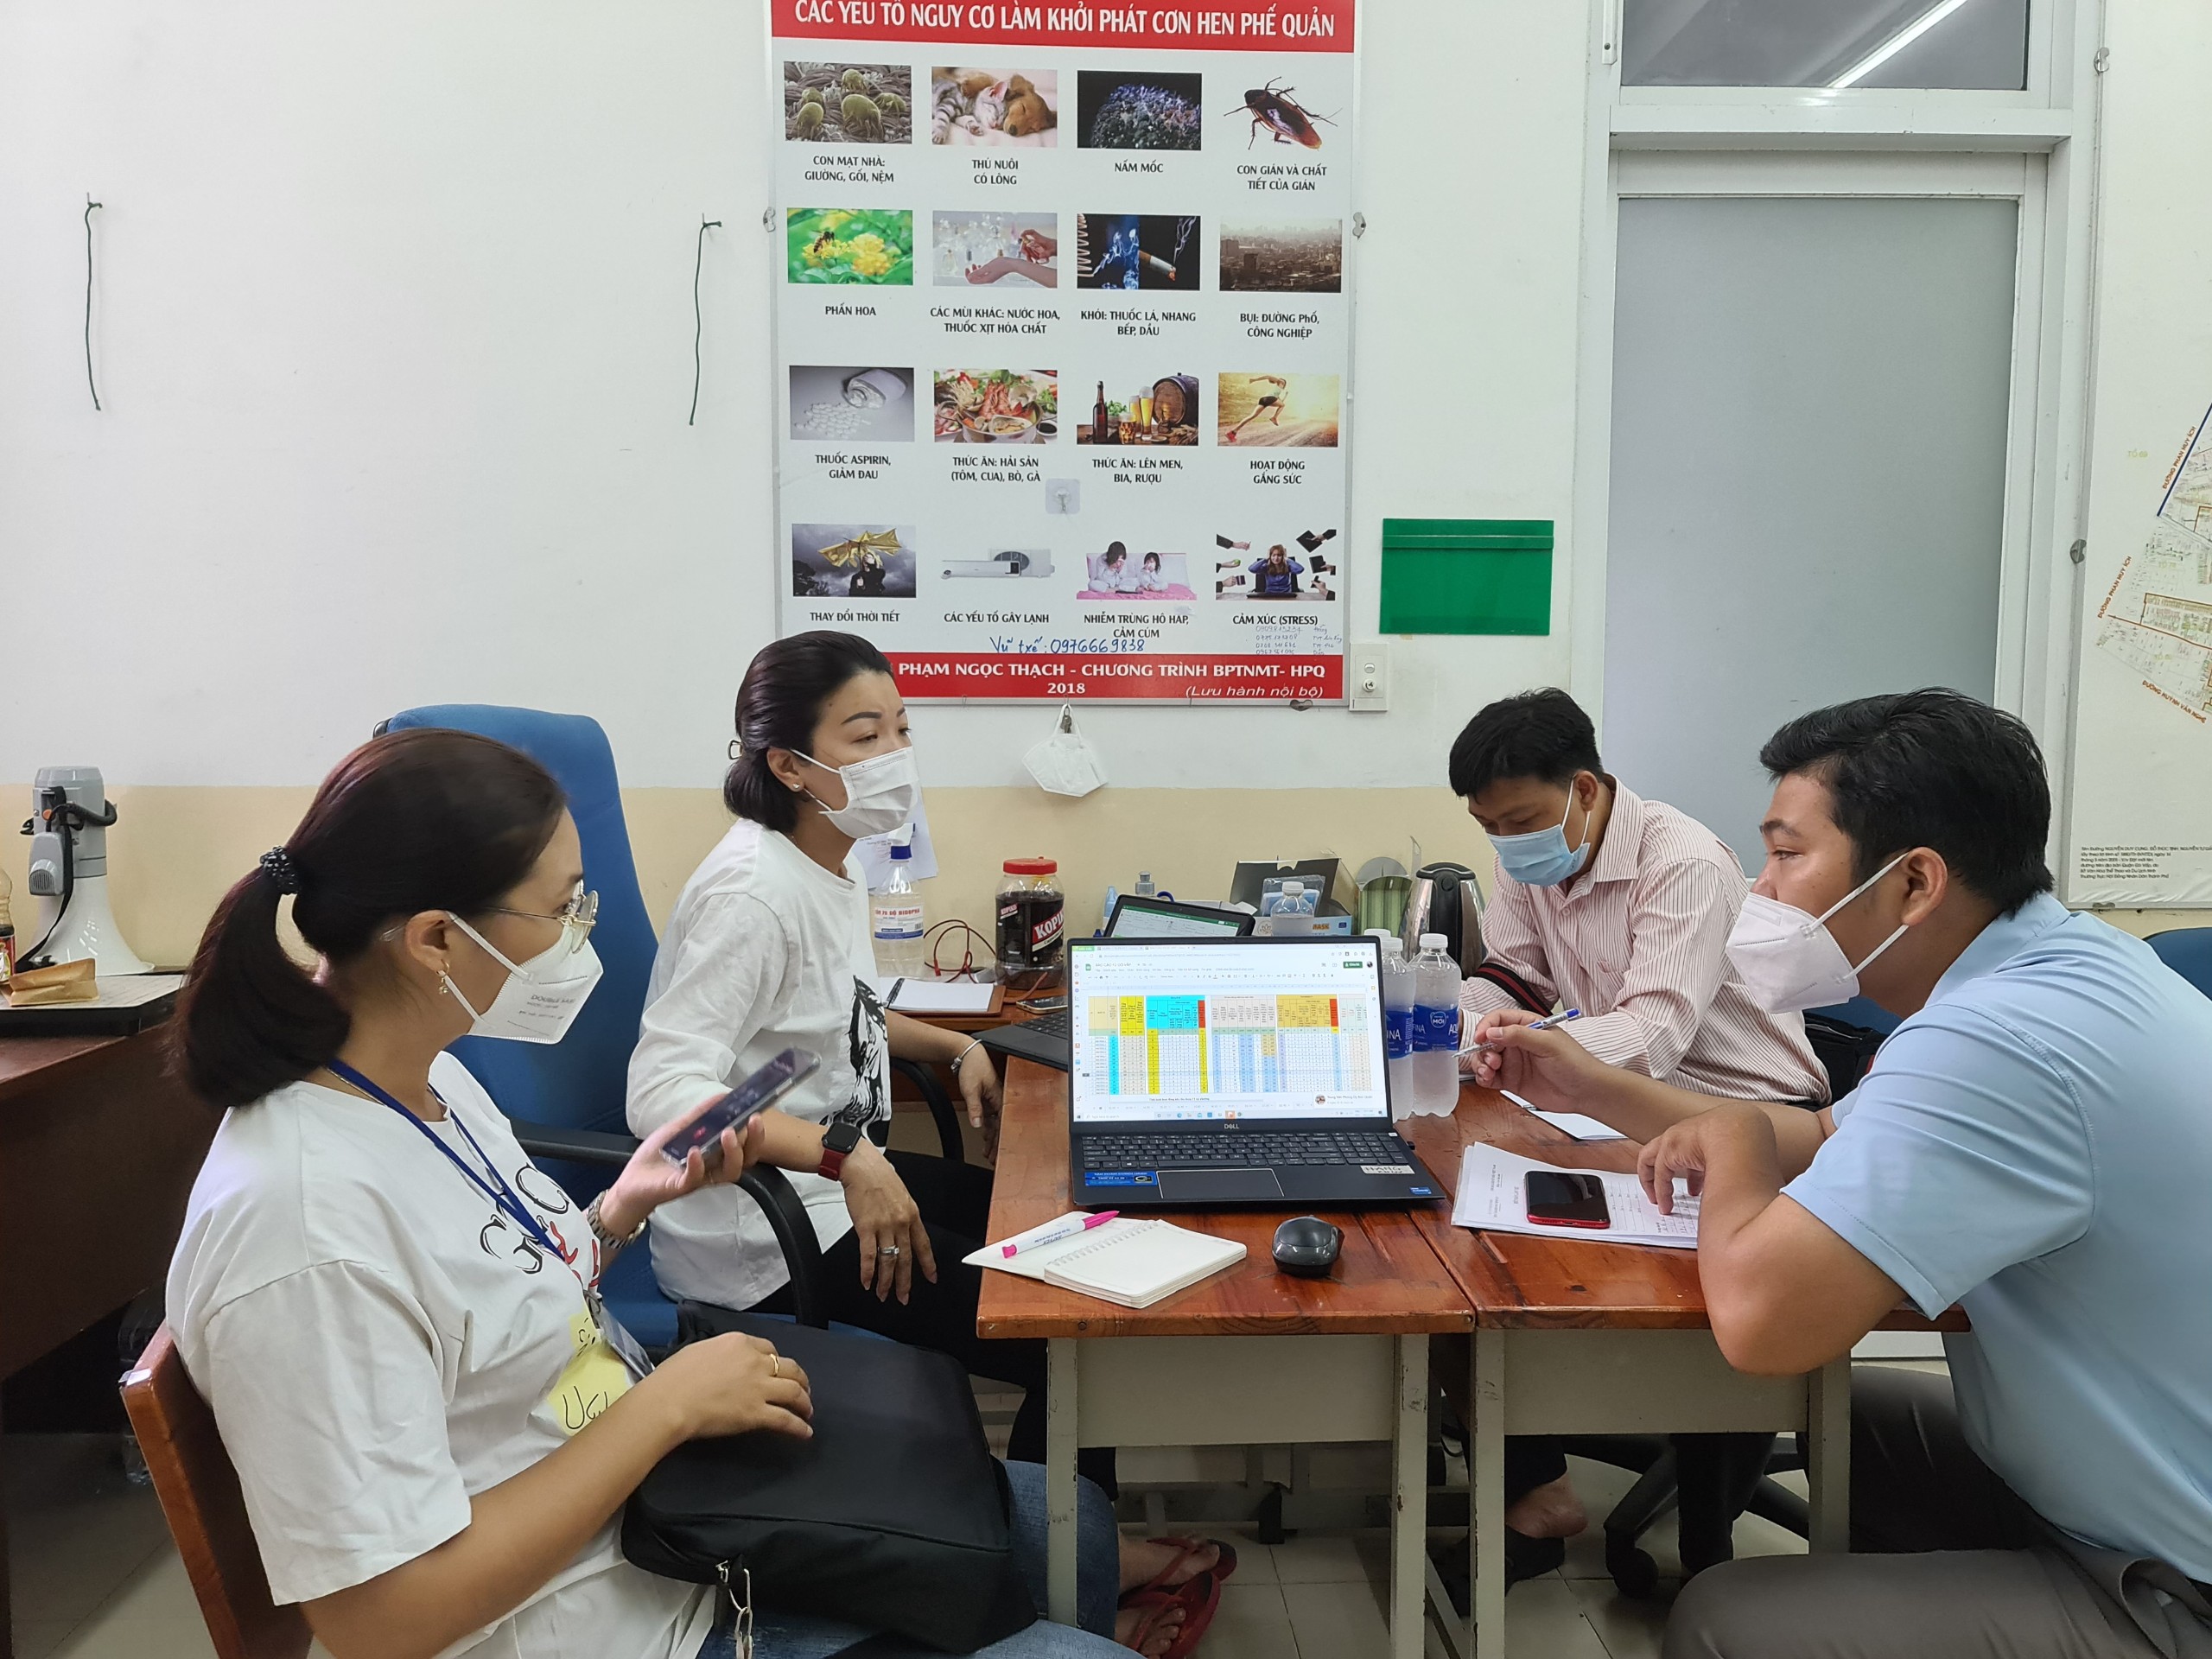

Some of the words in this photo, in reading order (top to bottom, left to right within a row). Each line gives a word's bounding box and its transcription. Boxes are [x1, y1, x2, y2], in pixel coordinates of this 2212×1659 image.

[910, 3, 964, 29] NGUY
[968, 3, 996, 29] CƠ
[1000, 1, 1041, 31] LÀM
[1046, 1, 1093, 32] KHỞI
[1098, 3, 1148, 34] PHÁT
[1152, 9, 1192, 35] CƠN
[1197, 11, 1235, 36] HEN
[1240, 3, 1277, 36] PHẾ
[1281, 5, 1335, 39] QUẢN
[812, 156, 835, 166] CON
[836, 156, 859, 168] MẠT
[861, 155, 886, 167] NHÀ:
[971, 157, 992, 169] THÚ
[994, 157, 1019, 170] NUÔI
[1114, 158, 1138, 173] NẤM
[1140, 159, 1164, 173] MỐC
[1236, 164, 1257, 175] CON
[1260, 163, 1284, 175] GIÁN
[1286, 163, 1300, 175] VÀ
[1301, 162, 1328, 176] CHẤT
[871, 169, 894, 185] NỆM
[973, 172, 988, 185] CÓ
[990, 172, 1017, 185] LÔNG
[1247, 176, 1268, 190] TIẾT
[1268, 177, 1289, 191] CỦA
[1291, 178, 1316, 191] GIÁN
[824, 302, 853, 315] PHẤN
[855, 306, 877, 316] HOA
[930, 305, 950, 318] CÁC
[952, 306, 972, 321] MÙI
[975, 306, 1005, 319] KHÁC:
[1007, 307, 1035, 319] NƯỚC
[1080, 308, 1108, 321] KHÓI:
[1109, 307, 1142, 321] THUỐC
[1161, 312, 1197, 321] NHANG
[1240, 313, 1259, 325] BỤI:
[1262, 311, 1296, 323] ĐƯỜNG
[944, 319, 977, 333] THUỐC
[979, 323, 995, 335] XỊT
[997, 321, 1019, 334] HÓA
[1020, 321, 1047, 334] CHẤT
[1139, 322, 1160, 336] DẦU
[1247, 325, 1274, 338] CÔNG
[1276, 326, 1313, 340] NGHIỆP
[815, 451, 849, 465] THUỐC
[2173, 450, 2184, 467] PHAN
[2181, 437, 2190, 450] HUY
[952, 454, 978, 467] THỨC
[980, 455, 997, 467] ĂN:
[1000, 454, 1017, 467] HẢI
[1019, 454, 1039, 467] SẢN
[1091, 456, 1117, 468] THỨC
[1119, 457, 1136, 468] ĂN:
[1139, 456, 1157, 469] LÊN
[1249, 460, 1276, 472] HOẠT
[1277, 458, 1306, 472] ĐỘNG
[829, 467, 855, 480] GIẢM
[857, 469, 879, 480] ĐAU
[1027, 470, 1041, 482] GÀ
[1135, 473, 1162, 486] RƯỢU
[1253, 471, 1281, 485] GẮNG
[1282, 473, 1302, 485] SỨC
[2108, 581, 2120, 597] PHAN
[2117, 567, 2126, 582] HUY
[809, 612, 835, 621] THAY
[836, 607, 854, 622] ĐỔI
[855, 610, 879, 622] THỜI
[880, 609, 900, 622] TIẾT
[944, 611, 963, 623] CÁC
[965, 610, 984, 623] YẾU
[986, 610, 1000, 623] TỐ
[1001, 611, 1022, 623] GÂY
[1024, 613, 1050, 626] LẠNH
[1084, 611, 1116, 624] NHIỄM
[1117, 613, 1149, 624] TRÙNG
[1152, 612, 1166, 624] HÔ
[1232, 612, 1255, 625] CẢM
[1256, 613, 1277, 625] XÚC
[1279, 615, 1319, 626] (STRESS)
[1113, 626, 1135, 639] CẢM
[1137, 626, 1160, 639] CÚM
[1050, 639, 1146, 654] 0976669838
[899, 663, 950, 678] PHẠM
[955, 663, 1004, 678] NGỌC
[1007, 664, 1065, 679] THẠCH
[1081, 663, 1154, 677] CHƯƠNG
[1157, 660, 1208, 677] TRÌNH
[1213, 664, 1286, 677] BPTNMT-
[1290, 664, 1325, 678] HPQ
[1047, 682, 1086, 694] 2018
[1185, 685, 1224, 698] (Lưu
[1226, 683, 1267, 697] hành
[1269, 683, 1296, 699] nội
[1298, 683, 1324, 699] bộ)
